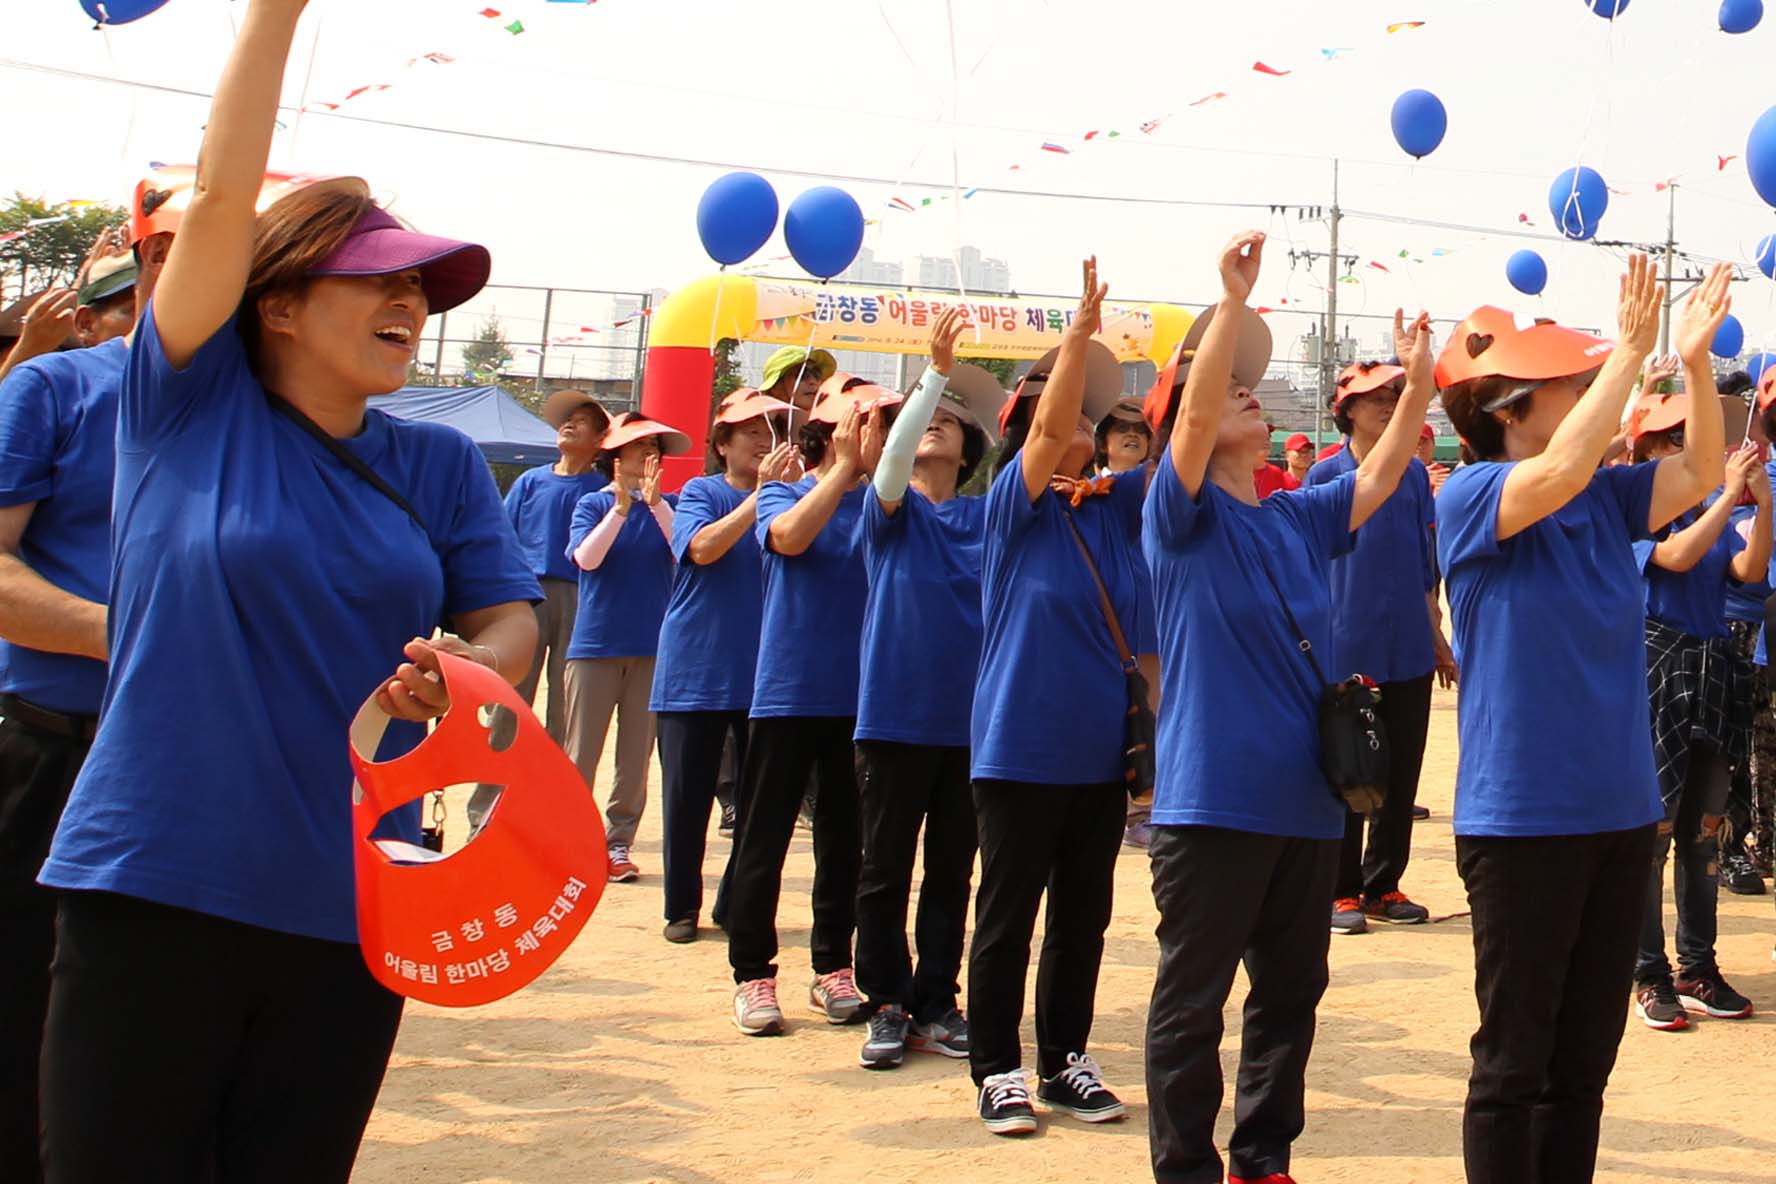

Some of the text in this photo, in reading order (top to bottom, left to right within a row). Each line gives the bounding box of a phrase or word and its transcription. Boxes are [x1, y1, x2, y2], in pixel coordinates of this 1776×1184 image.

[813, 293, 879, 324] 금창동
[956, 303, 1017, 332] 한마당
[384, 876, 587, 984] 어울림 한마당 체육대회
